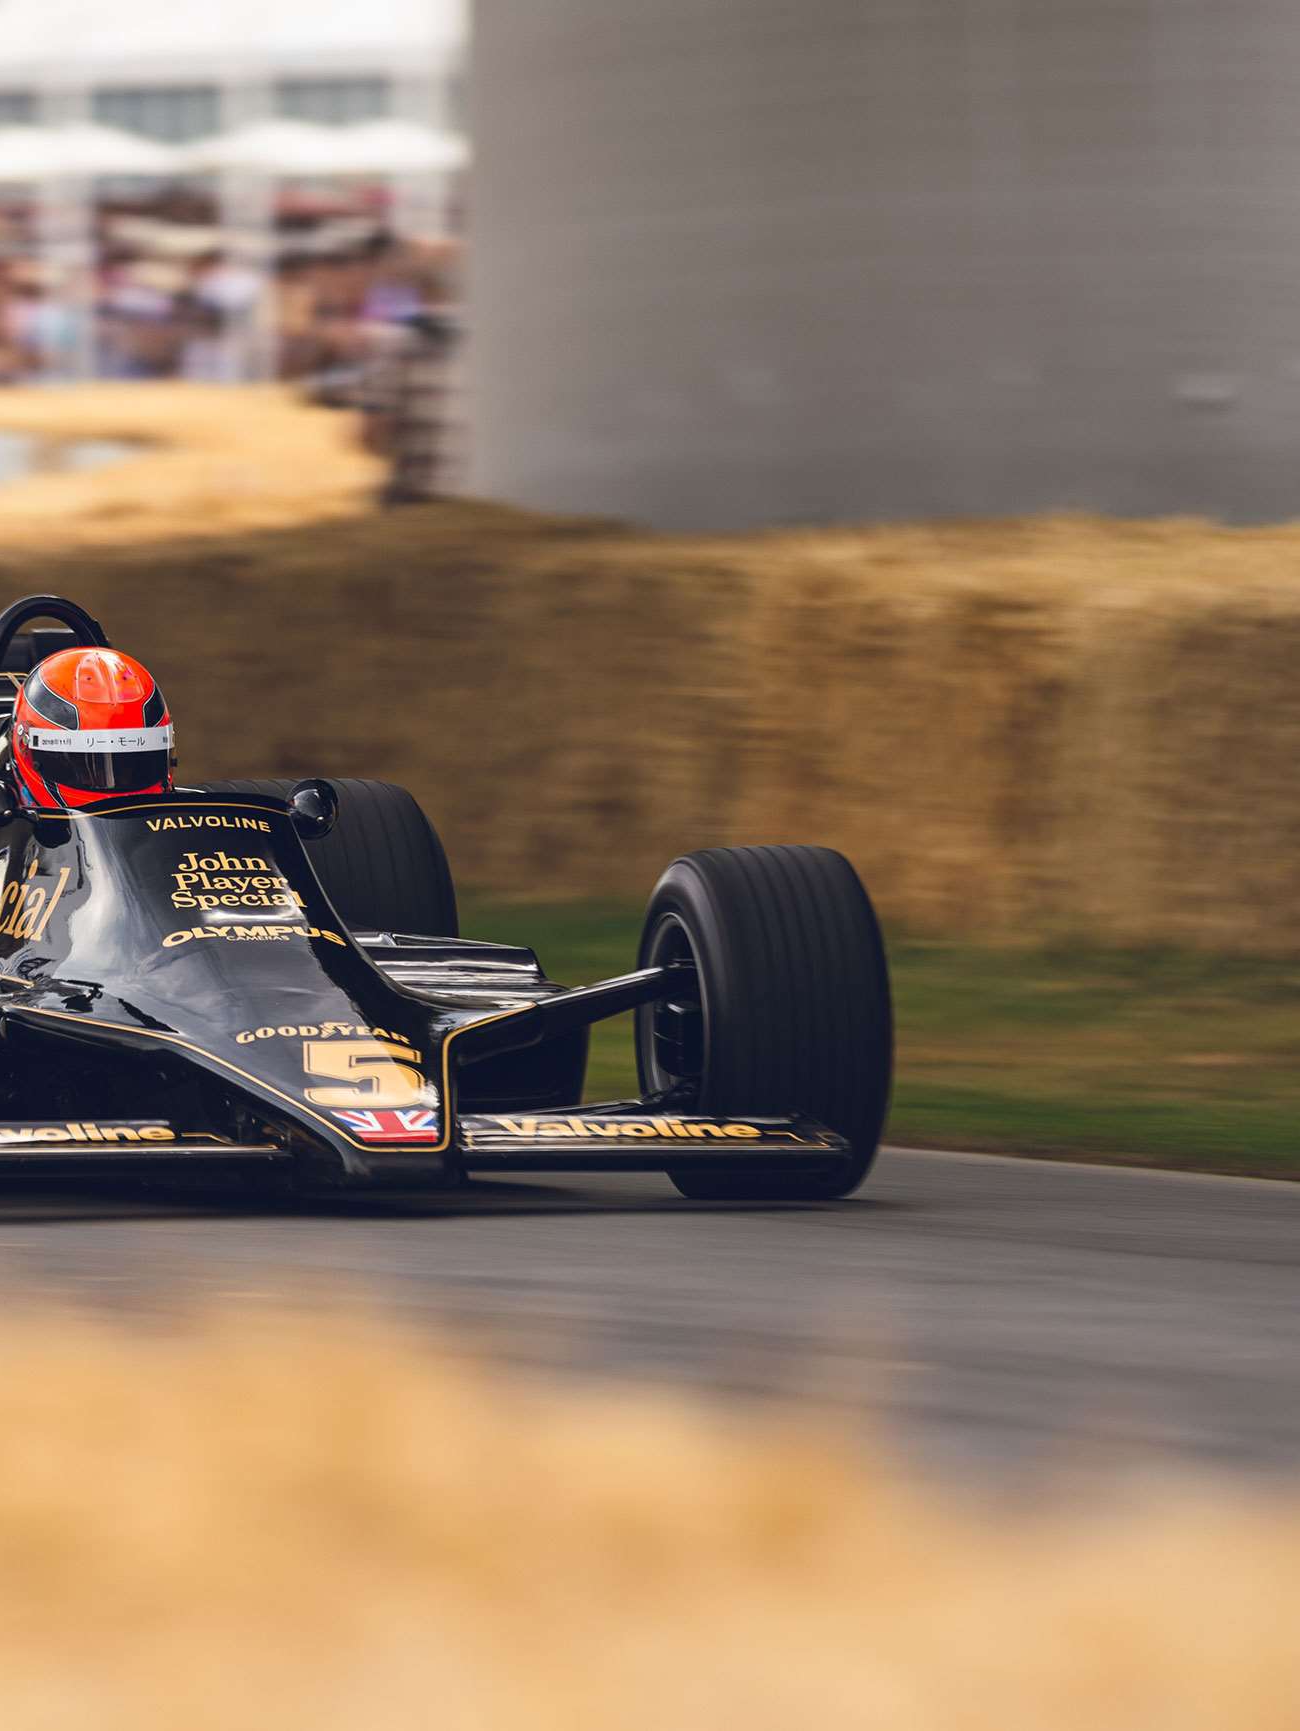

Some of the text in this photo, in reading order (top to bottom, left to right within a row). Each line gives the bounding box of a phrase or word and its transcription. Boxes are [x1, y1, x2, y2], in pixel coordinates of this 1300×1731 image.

[146, 815, 272, 833] VALVOLINE
[178, 851, 271, 872] John
[171, 872, 288, 893] Player
[170, 889, 307, 910] Special
[162, 925, 347, 947] OLYMPUS
[235, 1021, 411, 1045] GOODYEAR
[302, 1040, 426, 1109] 5
[499, 1117, 763, 1139] Valvoline
